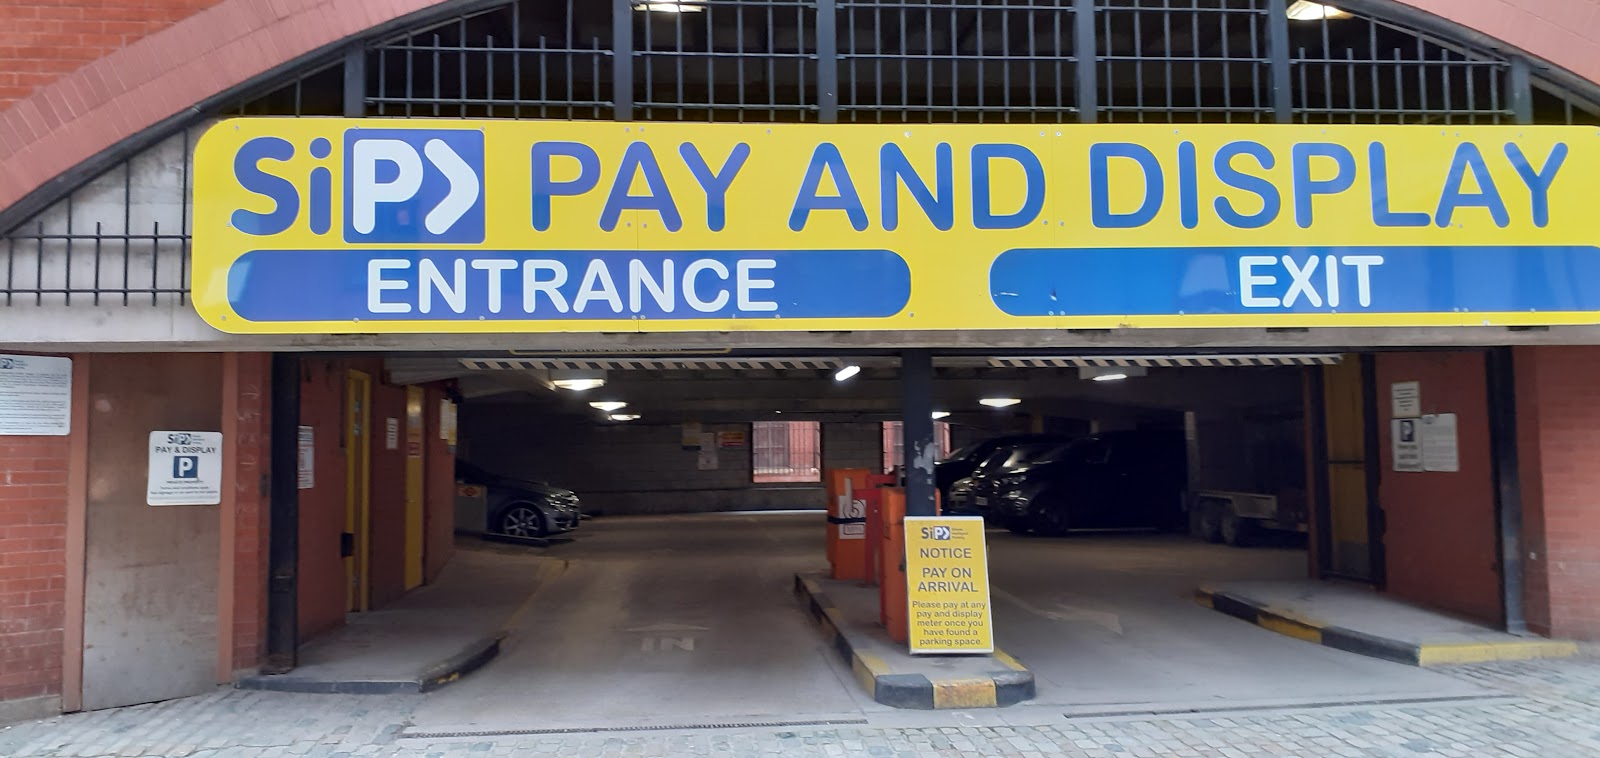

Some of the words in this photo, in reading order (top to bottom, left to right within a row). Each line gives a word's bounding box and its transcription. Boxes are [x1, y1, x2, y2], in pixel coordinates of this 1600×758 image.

[531, 141, 751, 233] PAY
[788, 142, 1046, 232] AND
[1089, 140, 1569, 230] DISPLAY
[367, 258, 778, 314] ENTRANCE
[1238, 254, 1384, 308] EXIT
[155, 446, 172, 454] PAY
[174, 446, 180, 454] &
[182, 446, 217, 454] DISPLAY
[179, 457, 193, 477] P
[920, 547, 972, 559] NOTICE
[922, 567, 947, 578] PAY
[951, 567, 972, 578] ON
[917, 581, 979, 592] ARRIVAL
[912, 600, 941, 608] Please
[943, 602, 958, 610] pay
[971, 602, 986, 610] any
[916, 611, 932, 619] pay
[934, 610, 950, 618] and
[952, 610, 983, 619] display
[968, 620, 984, 628] you
[946, 628, 971, 636] found
[919, 638, 952, 646] parking
[954, 638, 983, 646] space.
